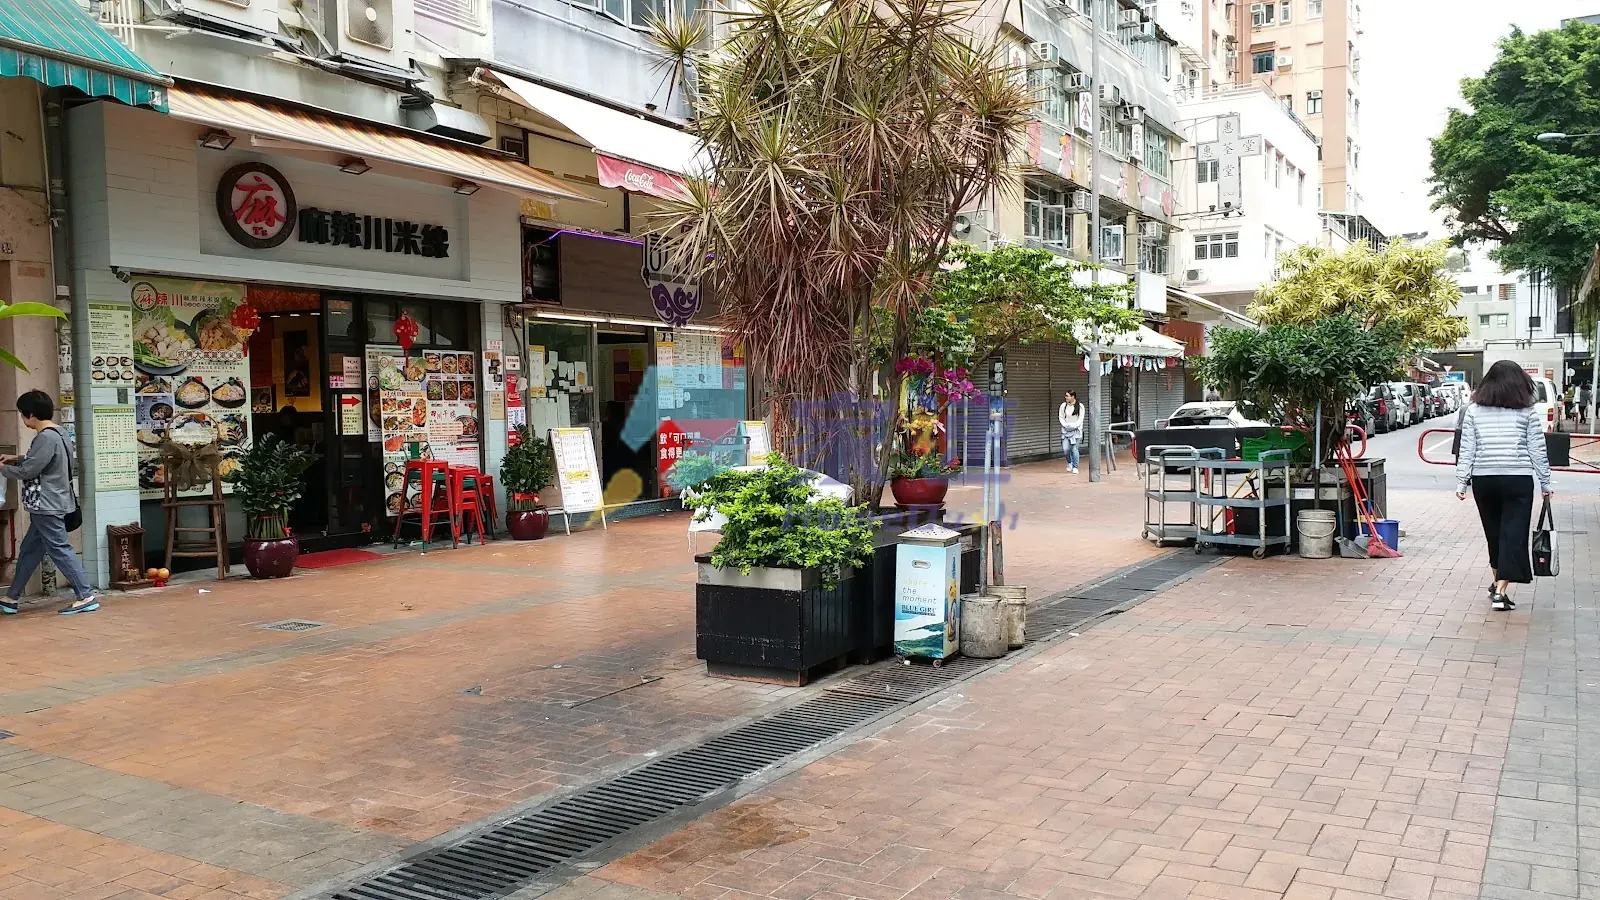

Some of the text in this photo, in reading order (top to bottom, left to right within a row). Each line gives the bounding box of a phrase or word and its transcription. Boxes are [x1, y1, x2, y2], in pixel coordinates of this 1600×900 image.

[902, 586, 917, 595] the
[902, 595, 937, 605] moment
[902, 604, 919, 612] BLUE
